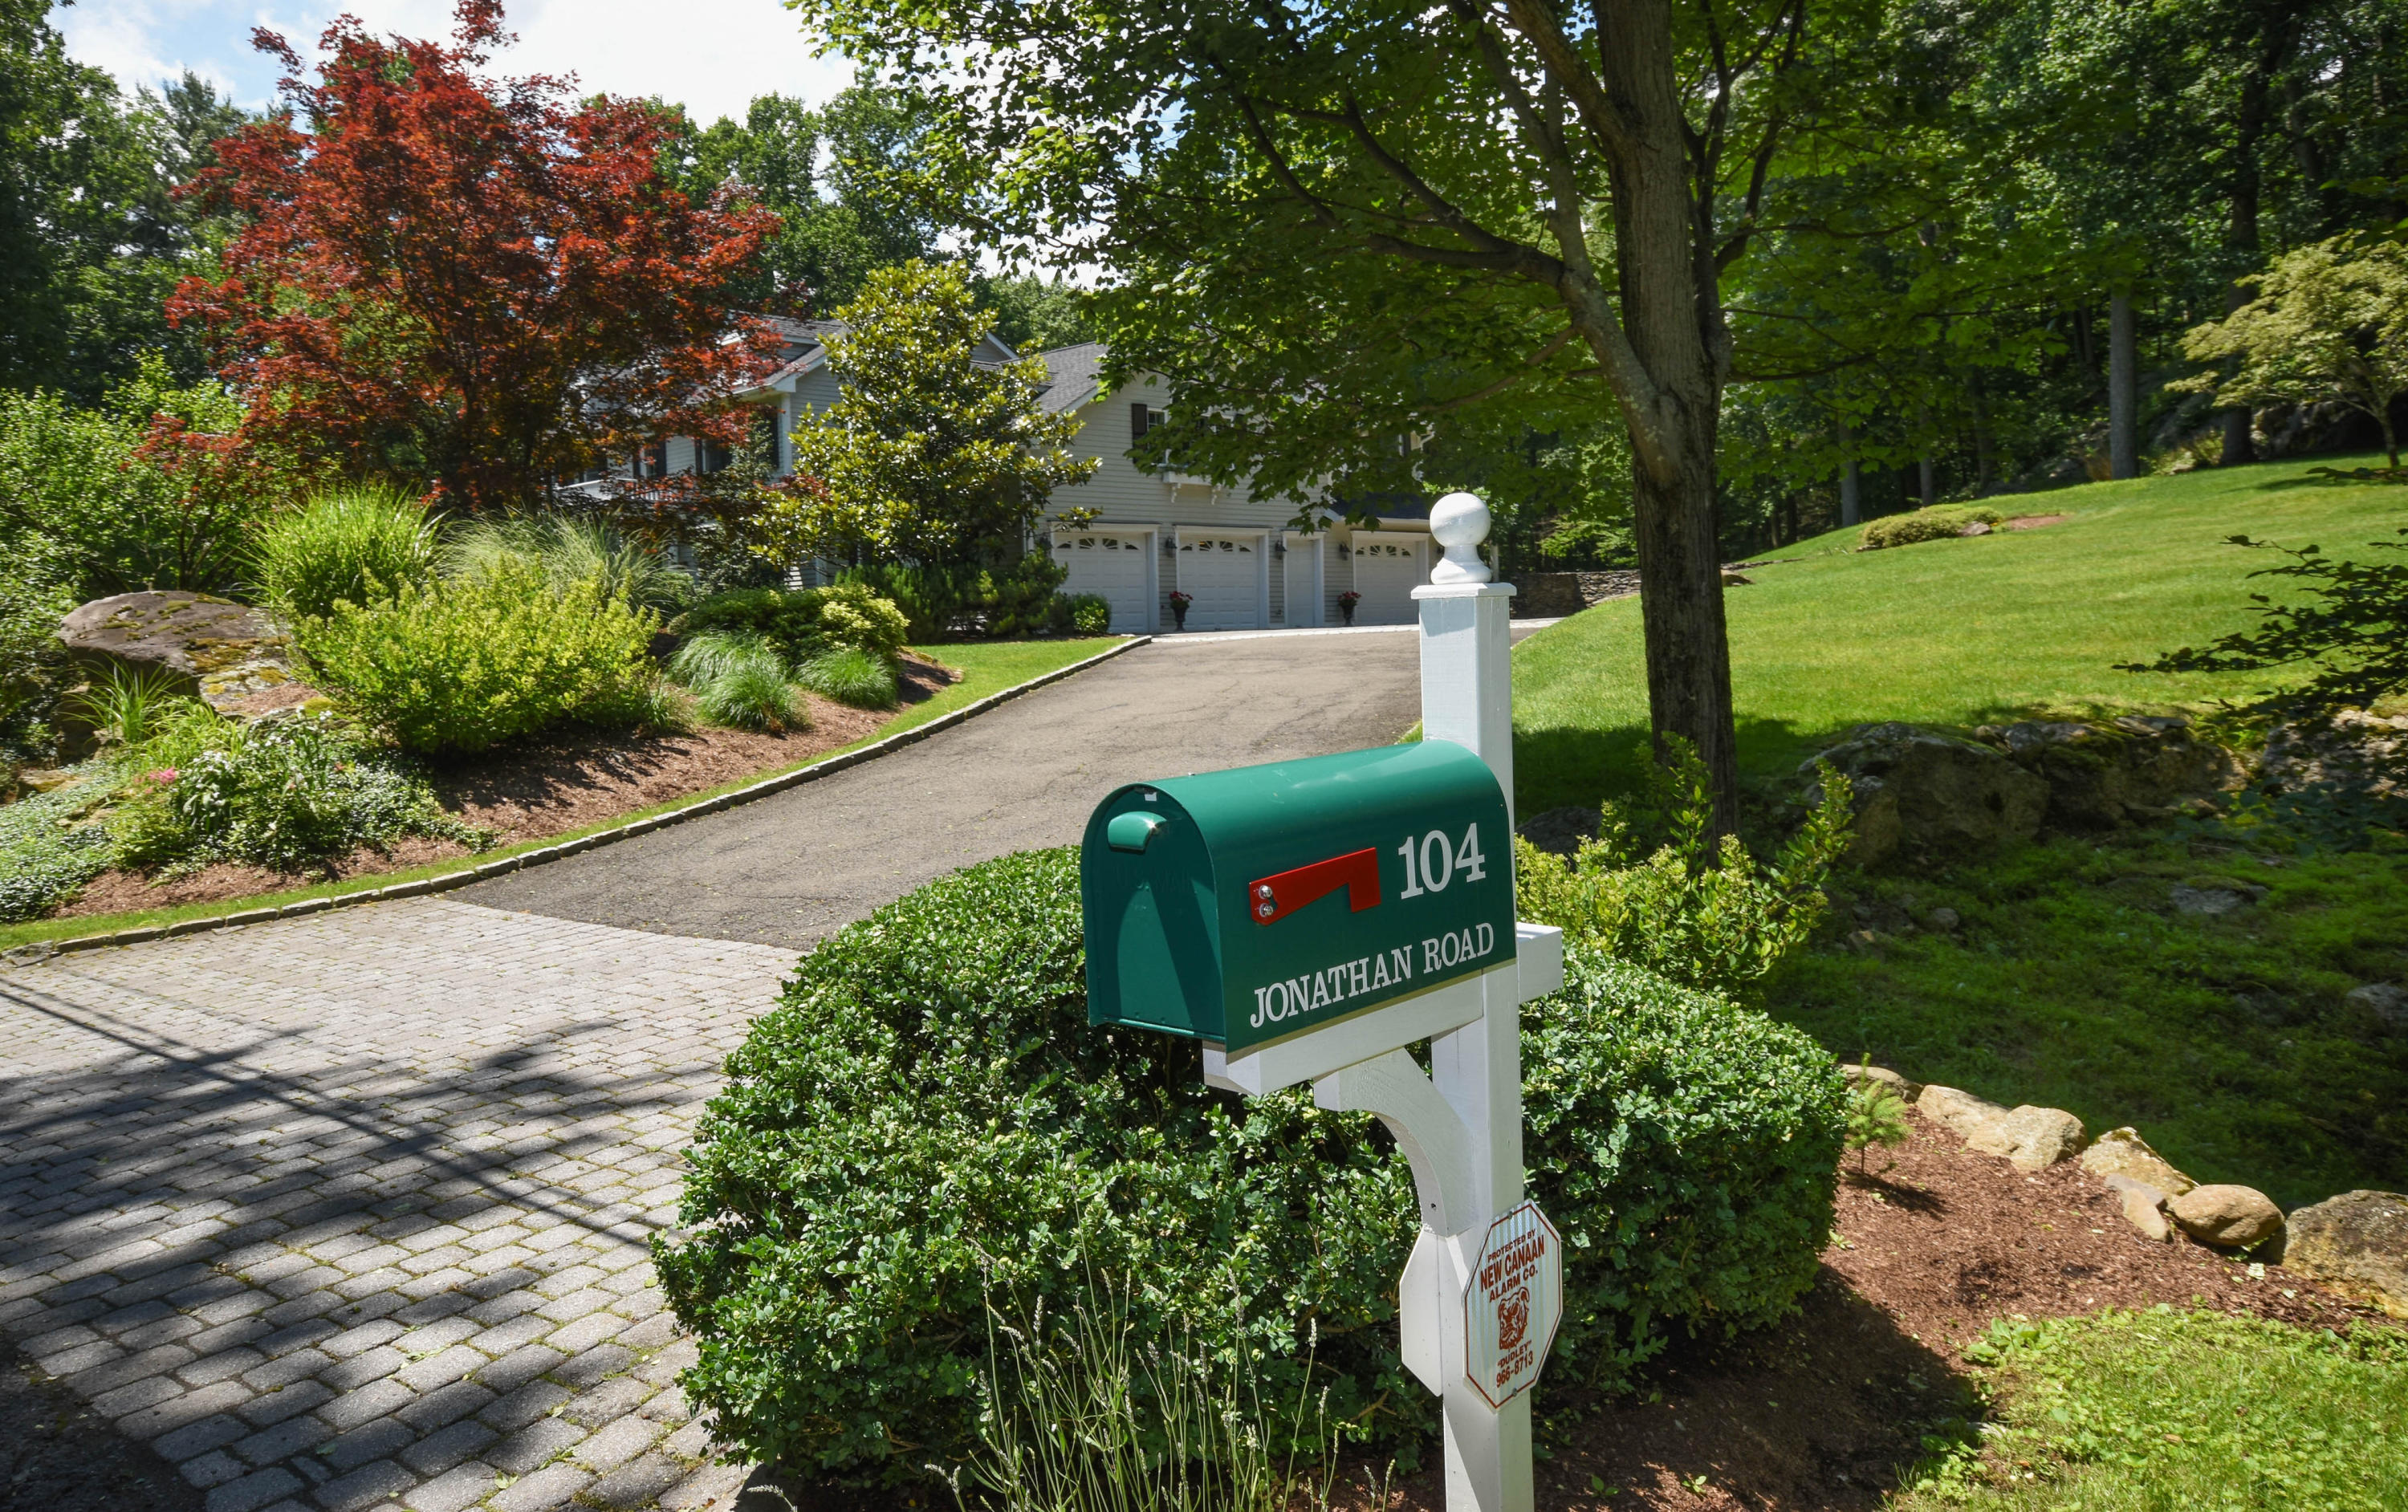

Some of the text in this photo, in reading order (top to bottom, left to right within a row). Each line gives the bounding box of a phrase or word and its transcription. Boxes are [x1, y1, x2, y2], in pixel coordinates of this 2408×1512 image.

[1398, 822, 1487, 900] 104
[1250, 922, 1495, 1028] JONATHAN ROAD
[1480, 1234, 1545, 1292] NEW CANAAN
[1487, 1229, 1536, 1262] PROTECTED BY
[1489, 1265, 1538, 1303] ALARM CO.
[1496, 1351, 1533, 1388] 966-8713
